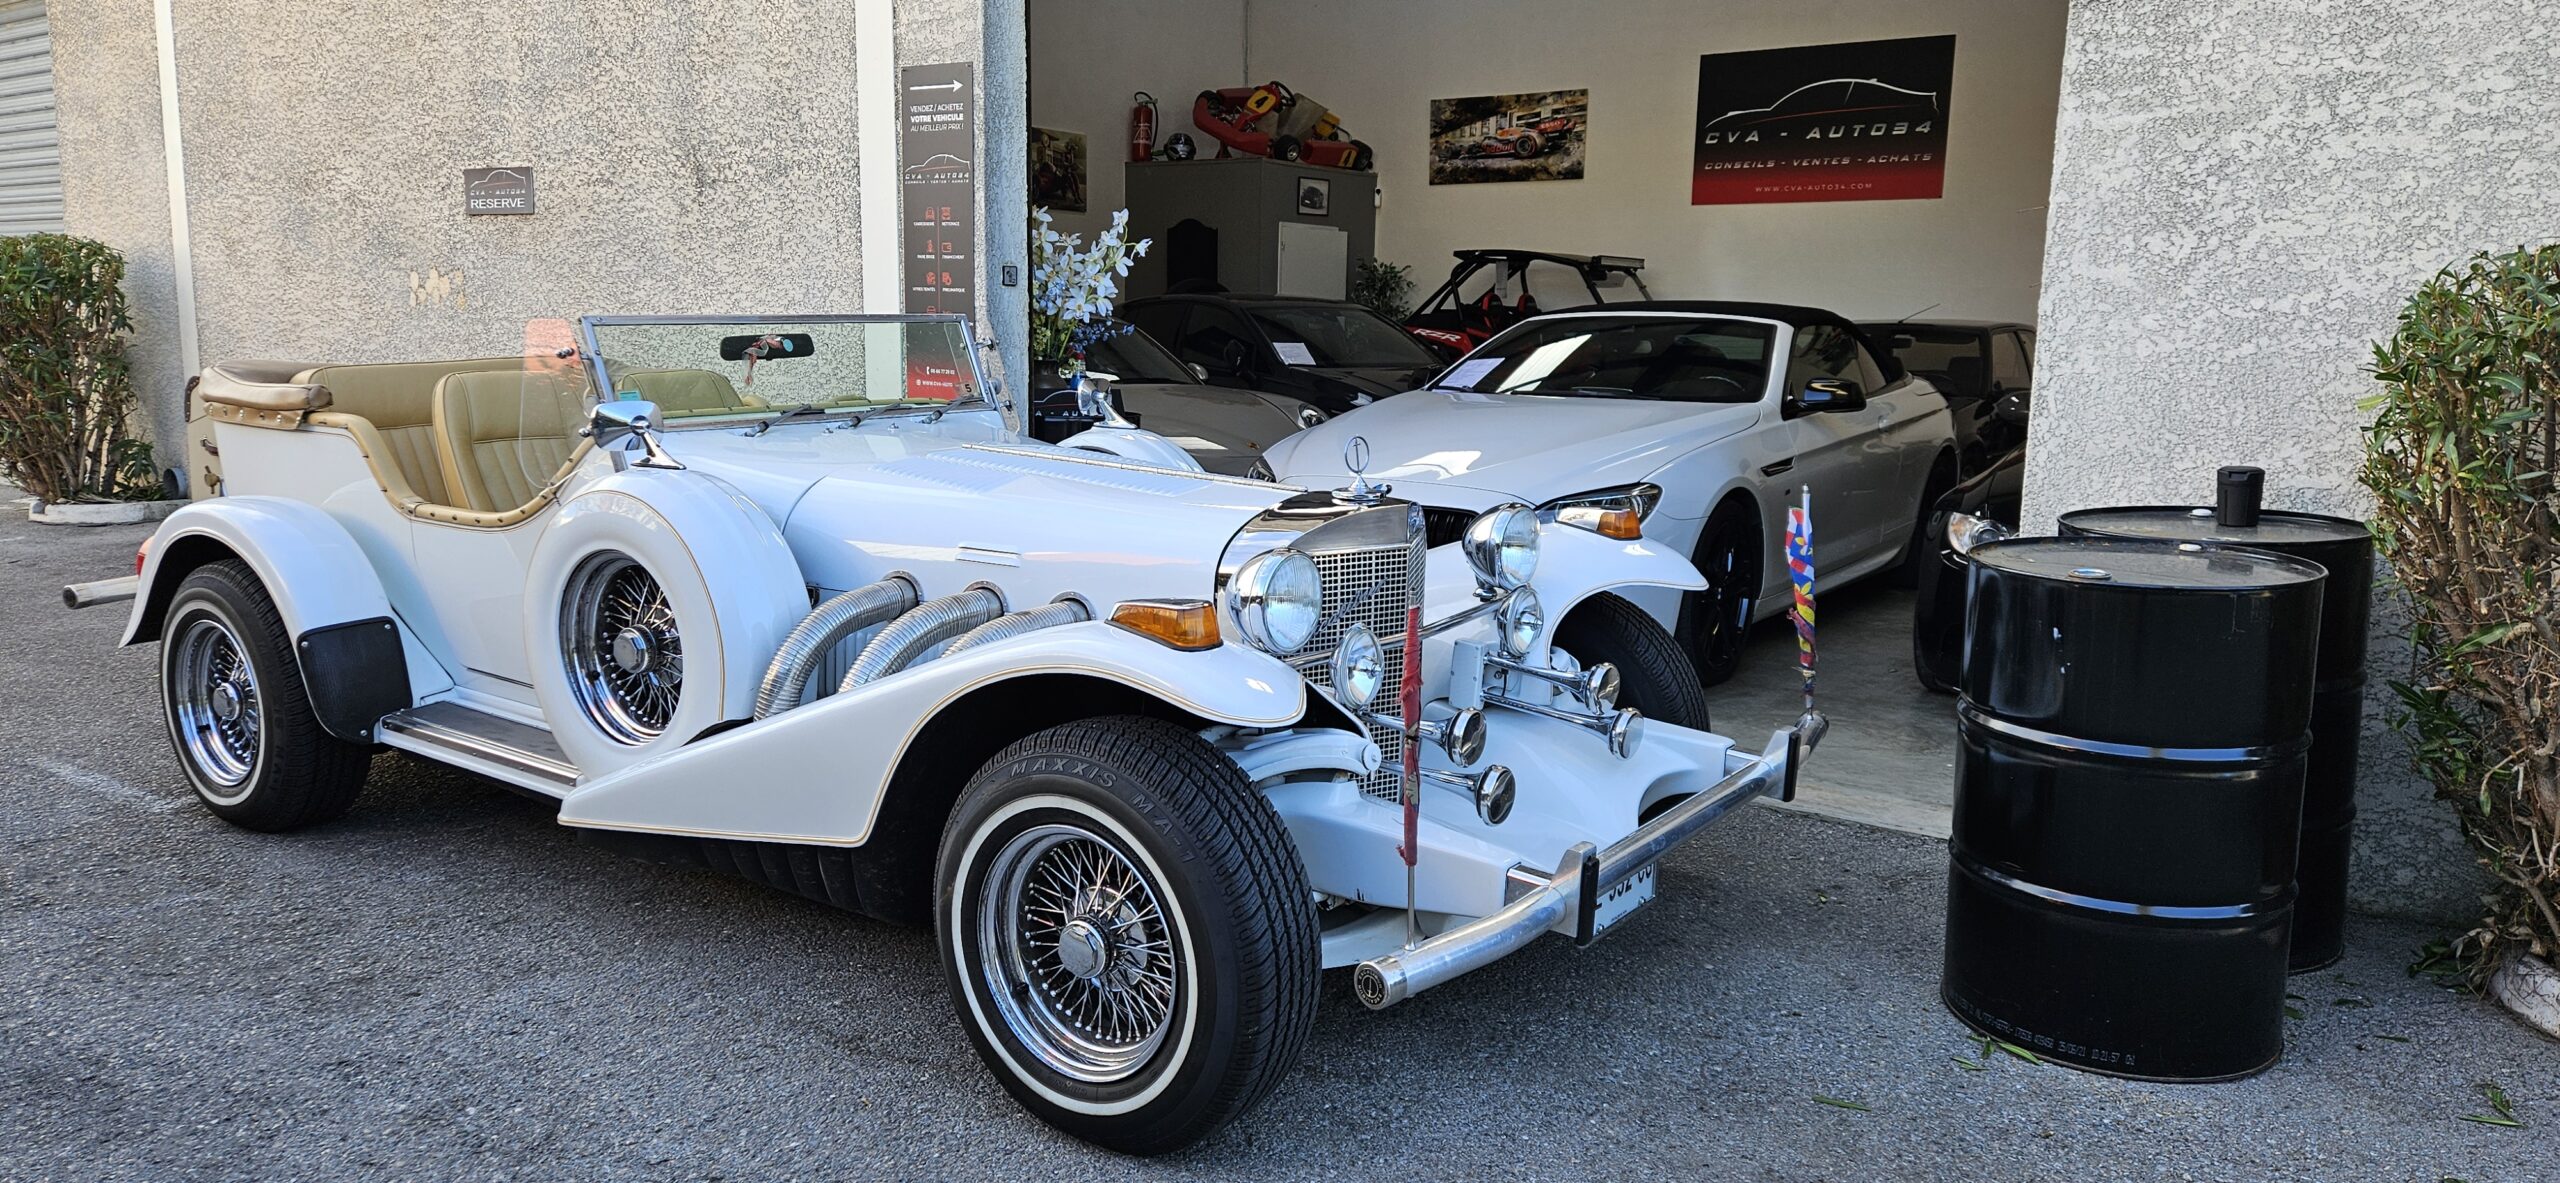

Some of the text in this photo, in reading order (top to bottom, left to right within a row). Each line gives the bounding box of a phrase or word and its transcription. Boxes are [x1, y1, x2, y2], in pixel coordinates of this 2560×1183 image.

[910, 104, 933, 112] VENDEZ
[937, 103, 964, 112] ACHETEZ
[1255, 96, 1268, 108] 4
[932, 113, 964, 122] VEHICULE
[920, 124, 947, 132] MEILLEUR
[1705, 130, 1760, 144] CVA
[1806, 120, 1932, 140] AUTO34
[1704, 159, 1775, 170] CONSEILS
[1792, 156, 1851, 166] VENTES
[1866, 152, 1933, 164] ACHATS
[1754, 182, 1873, 193] WWW.CVA-AUTO34.COM
[471, 198, 526, 209] RESERVE
[1413, 328, 1462, 342] RZR
[964, 384, 972, 392] 5
[1011, 758, 1117, 787] MAXXIS
